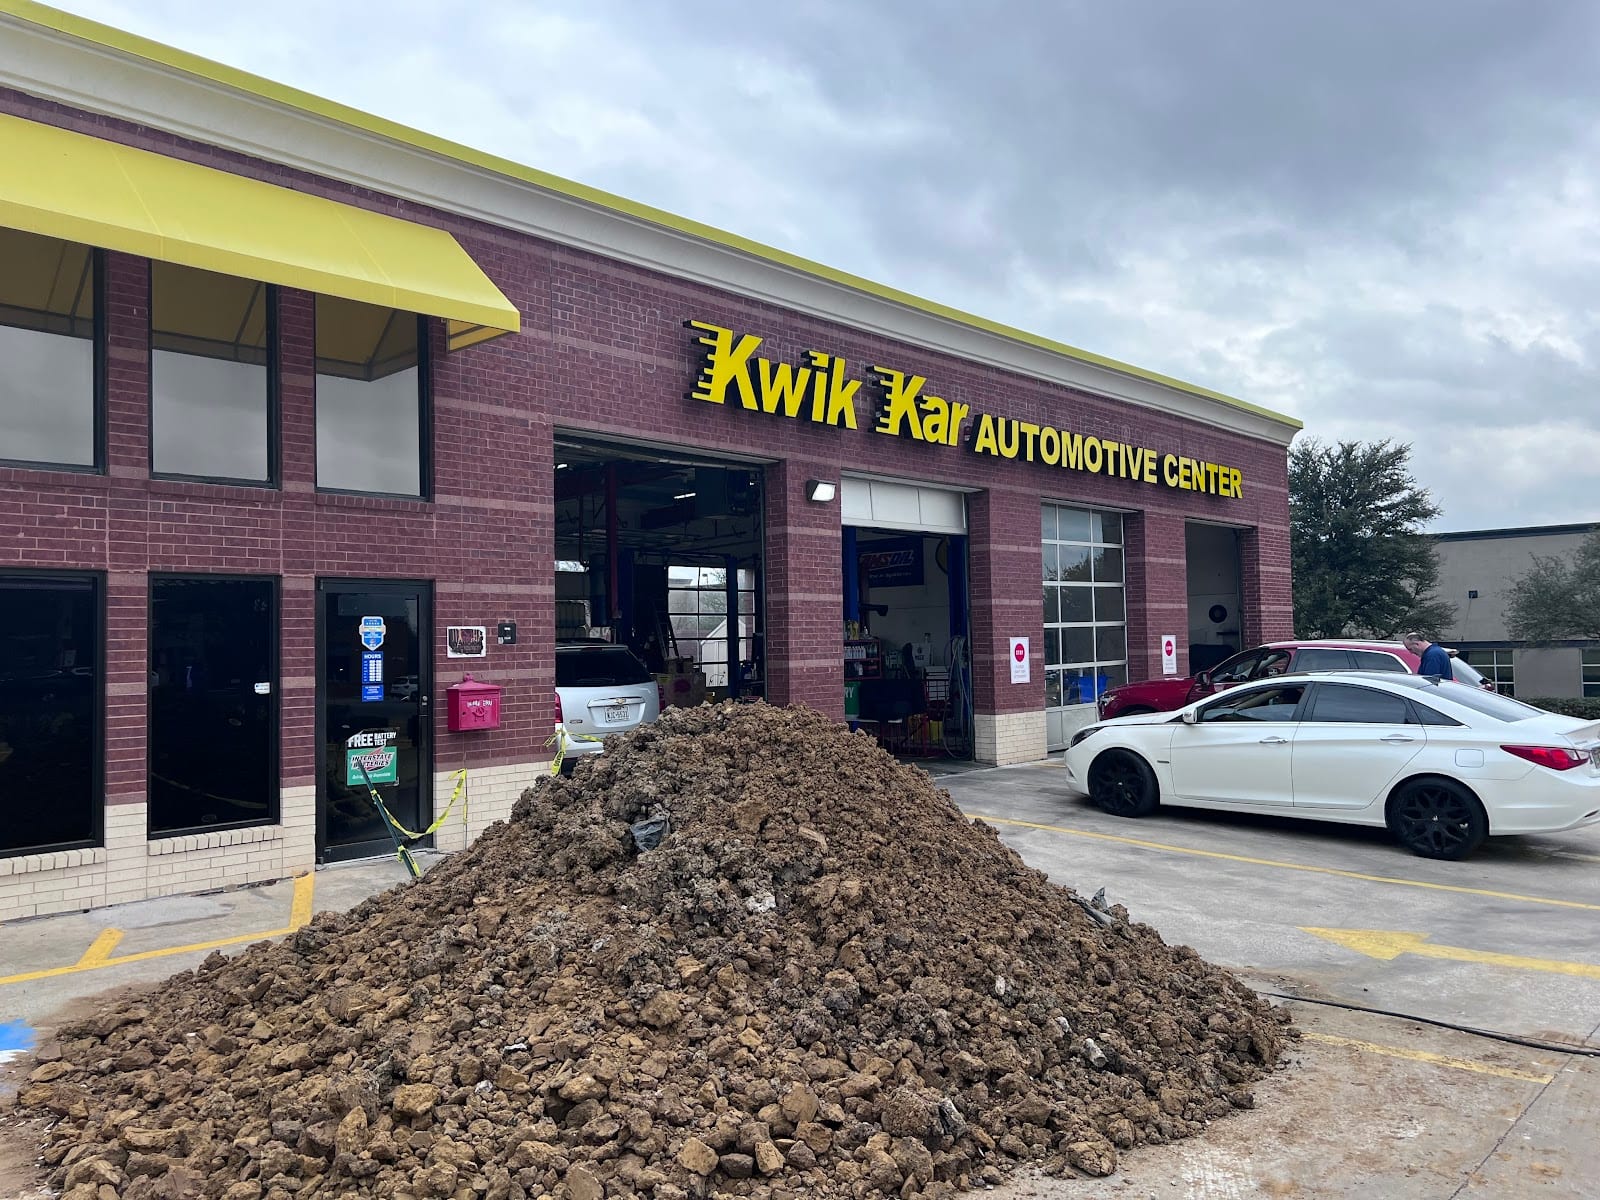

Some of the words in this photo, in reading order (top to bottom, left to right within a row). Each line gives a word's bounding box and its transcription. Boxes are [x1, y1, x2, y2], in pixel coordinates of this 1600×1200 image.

[690, 320, 862, 430] Kwik
[873, 366, 970, 446] Kar
[975, 413, 1157, 484] AUTOMOTIVE
[1163, 453, 1243, 498] CENTER
[347, 733, 374, 748] FREE
[374, 731, 397, 740] BATTERY
[352, 753, 393, 762] INTERSTATE
[353, 760, 390, 768] BTERIES
